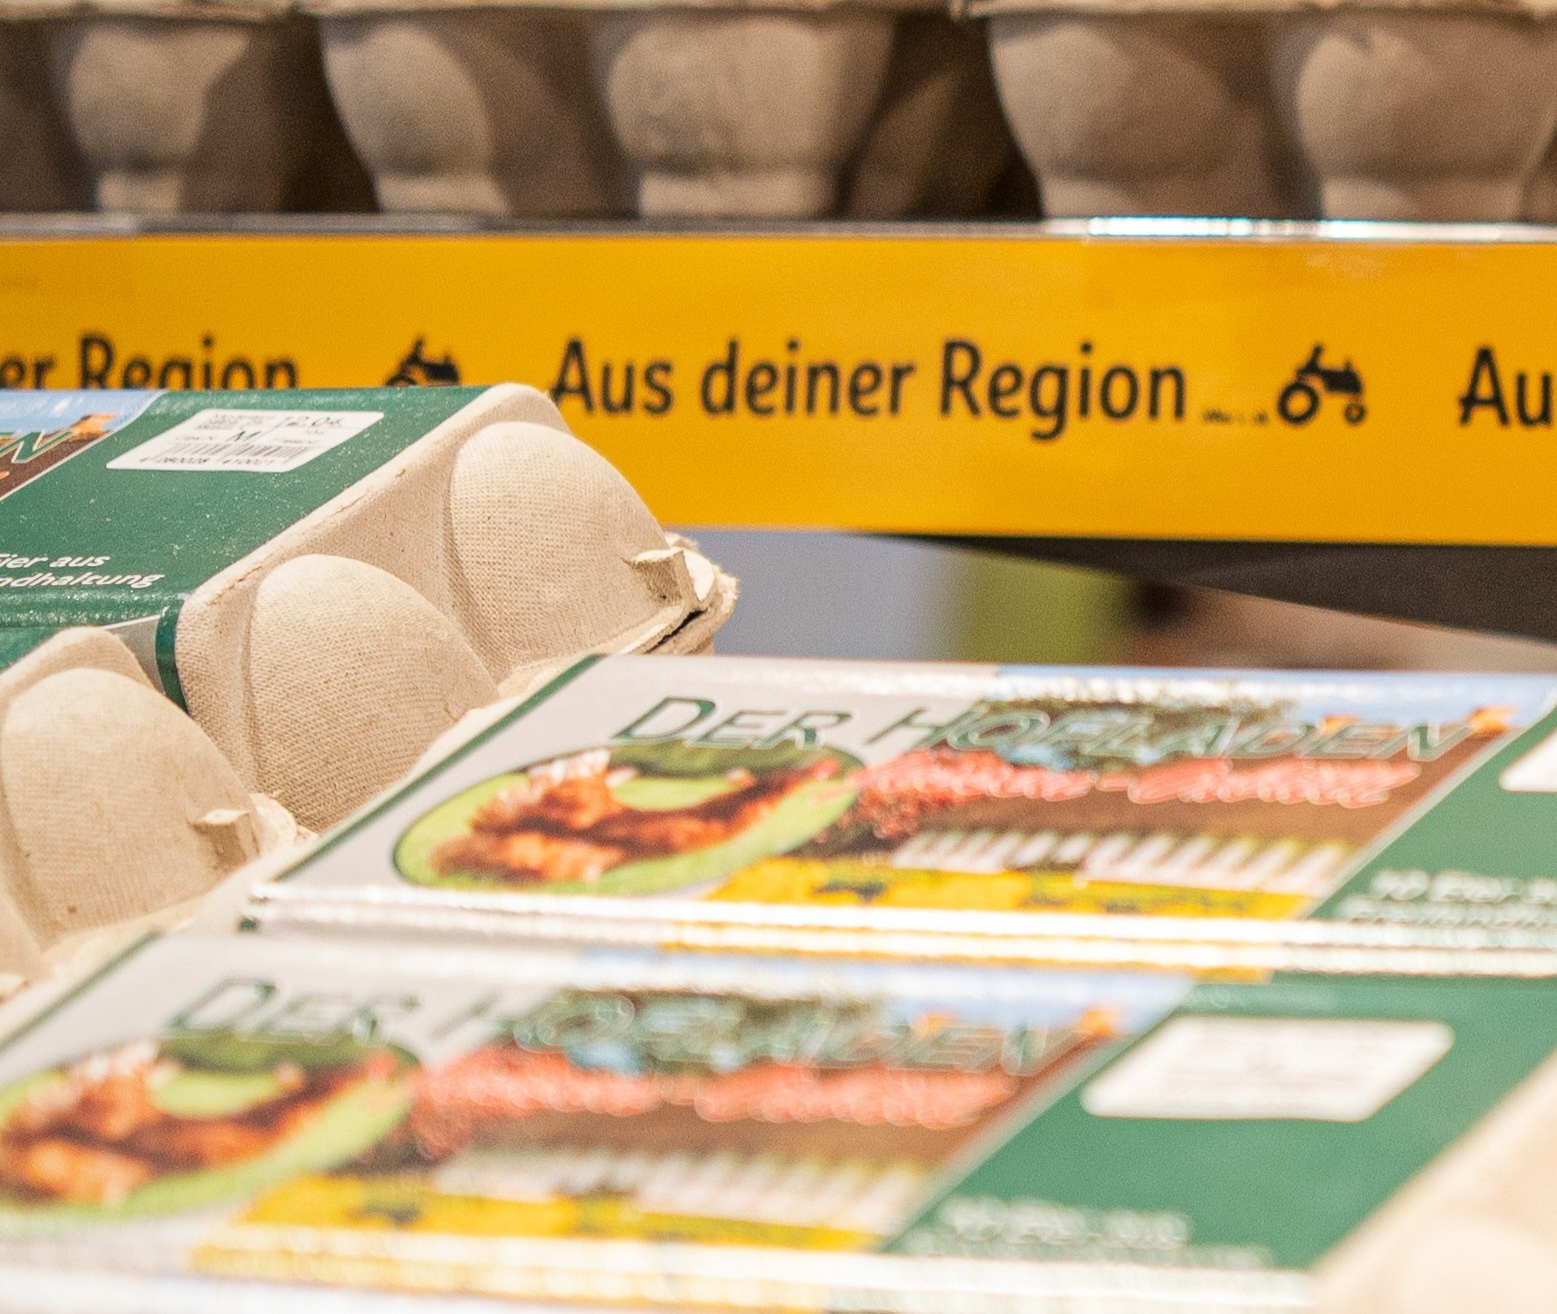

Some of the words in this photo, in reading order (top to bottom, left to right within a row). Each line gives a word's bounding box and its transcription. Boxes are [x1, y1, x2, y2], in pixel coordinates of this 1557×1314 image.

[553, 338, 674, 415] Aus
[700, 339, 915, 418] deiner
[940, 339, 1187, 441] Region
[49, 555, 110, 568] aus
[612, 696, 851, 751] DER
